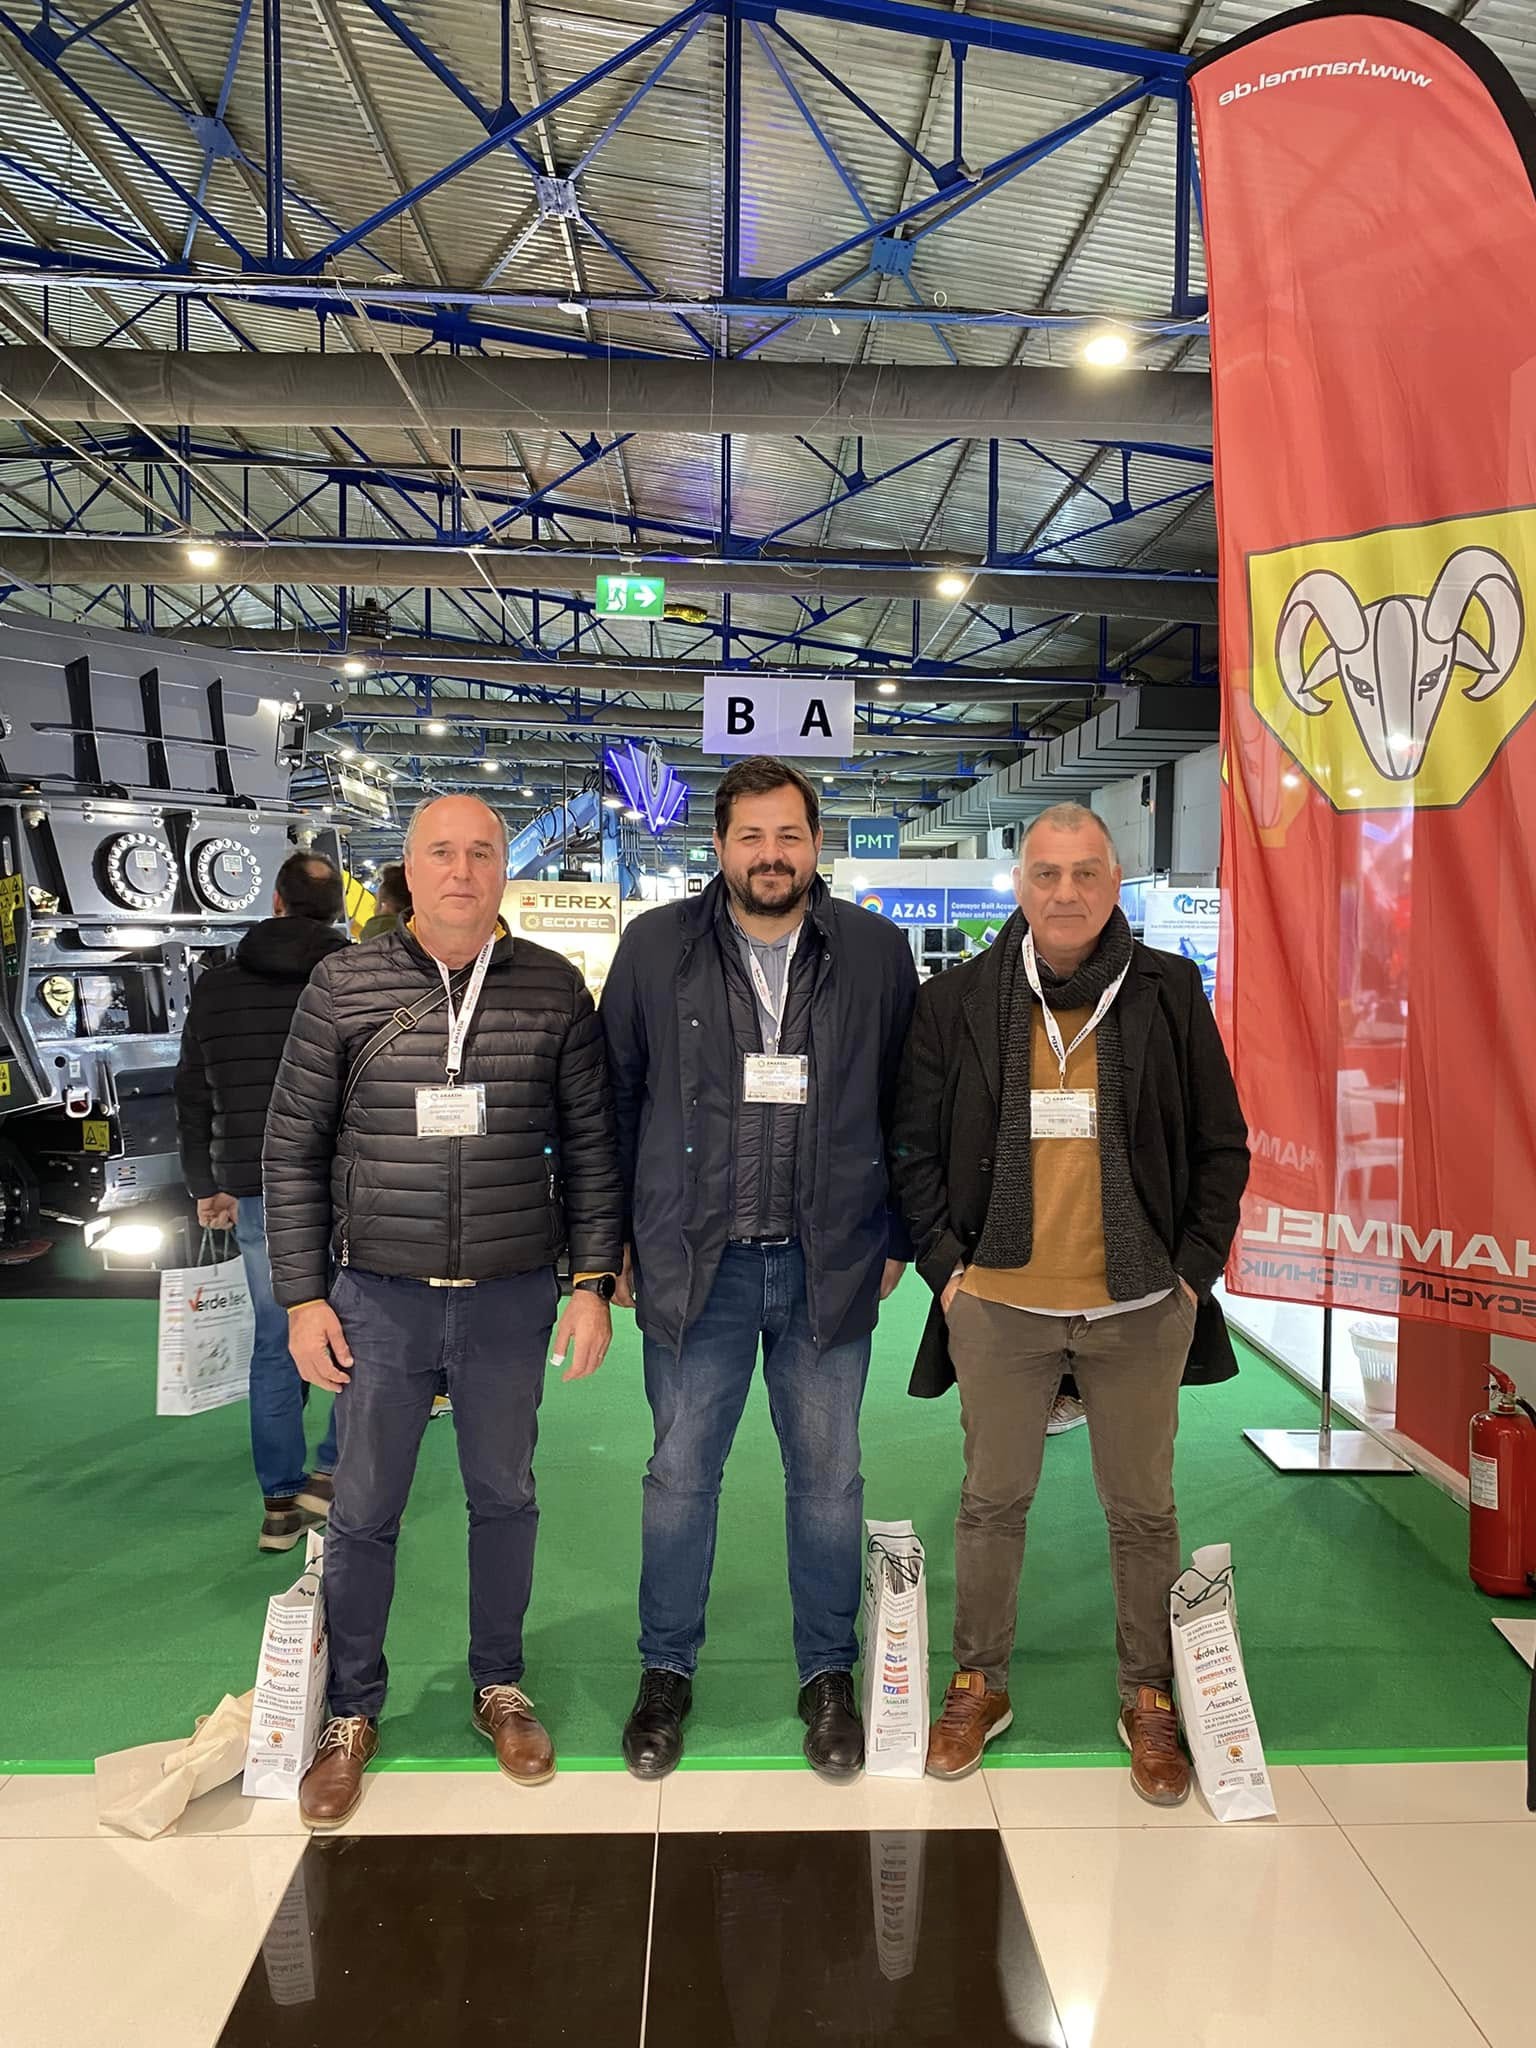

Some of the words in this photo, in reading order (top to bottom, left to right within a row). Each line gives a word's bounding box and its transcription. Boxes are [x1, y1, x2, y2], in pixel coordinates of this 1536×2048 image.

[727, 696, 755, 735] B
[800, 699, 833, 737] A
[855, 834, 895, 849] PMT
[539, 894, 613, 909] TEREX
[891, 903, 937, 918] AZAS
[542, 918, 610, 929] ECOTEC
